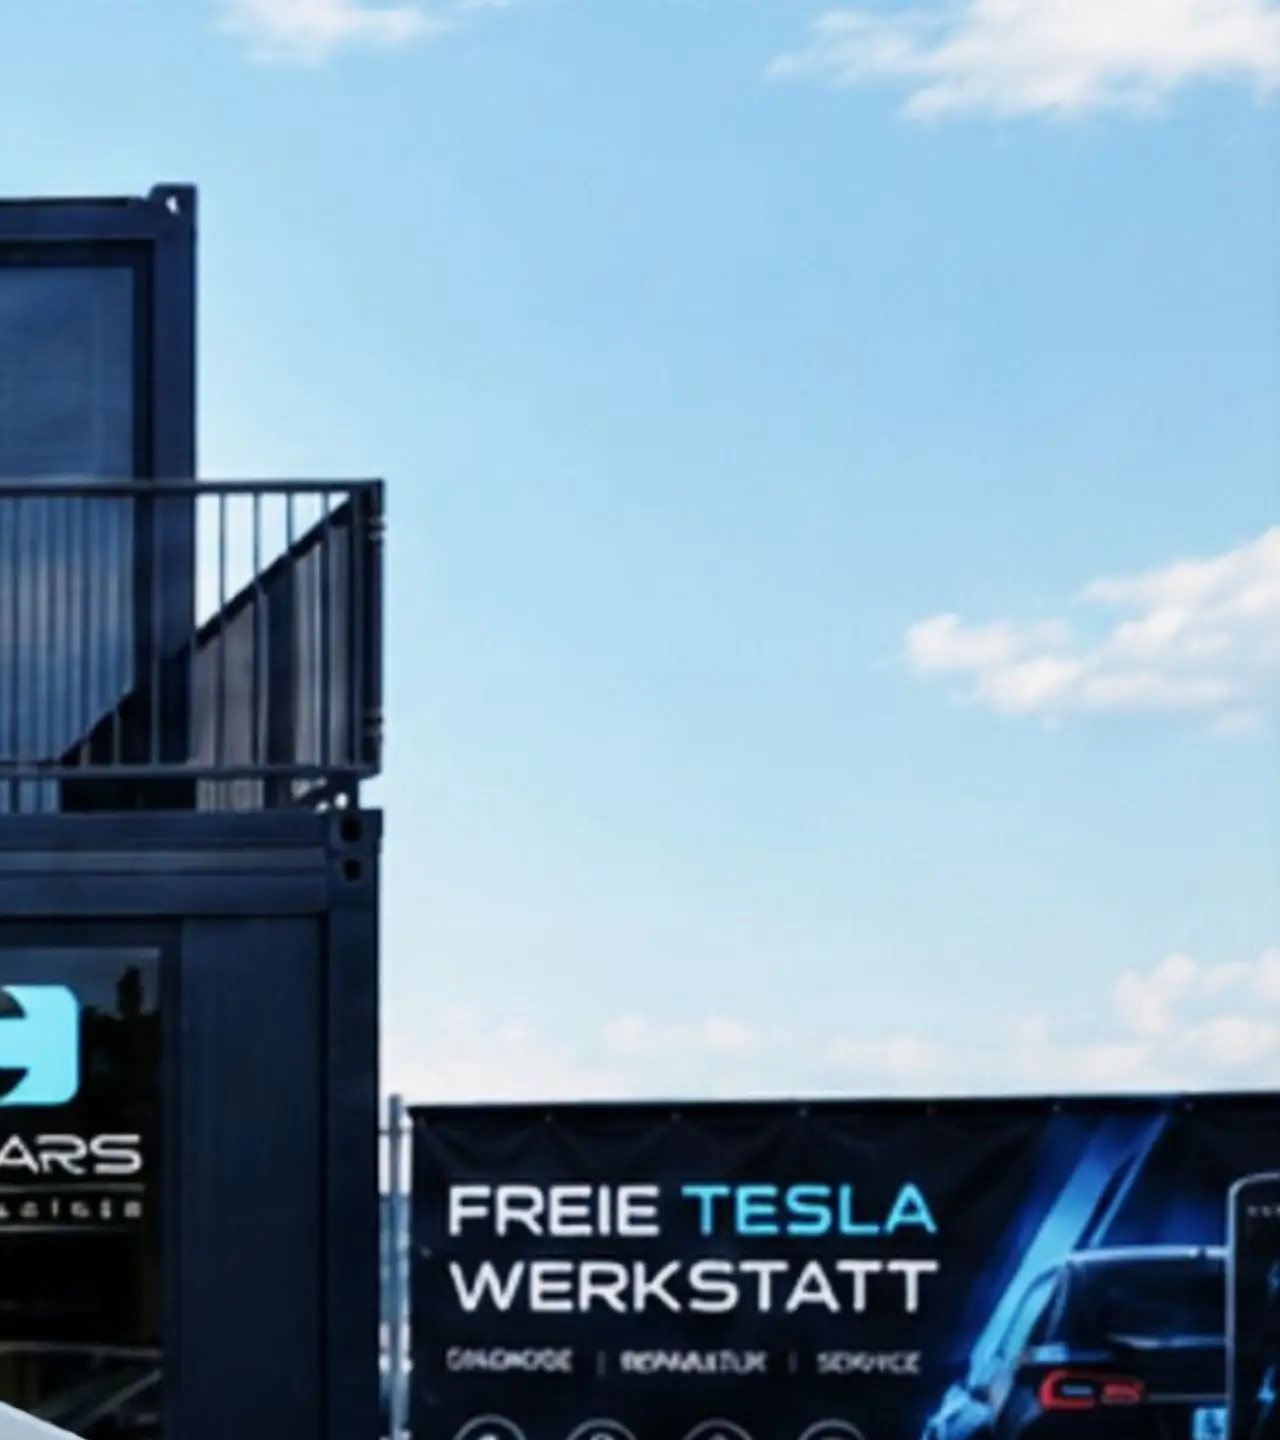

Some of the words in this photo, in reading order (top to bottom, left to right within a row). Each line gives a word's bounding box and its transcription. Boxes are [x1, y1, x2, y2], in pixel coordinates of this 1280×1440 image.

[448, 1184, 660, 1237] FREIE
[681, 1183, 938, 1236] TESLA
[449, 1260, 939, 1313] WERKSTATT
